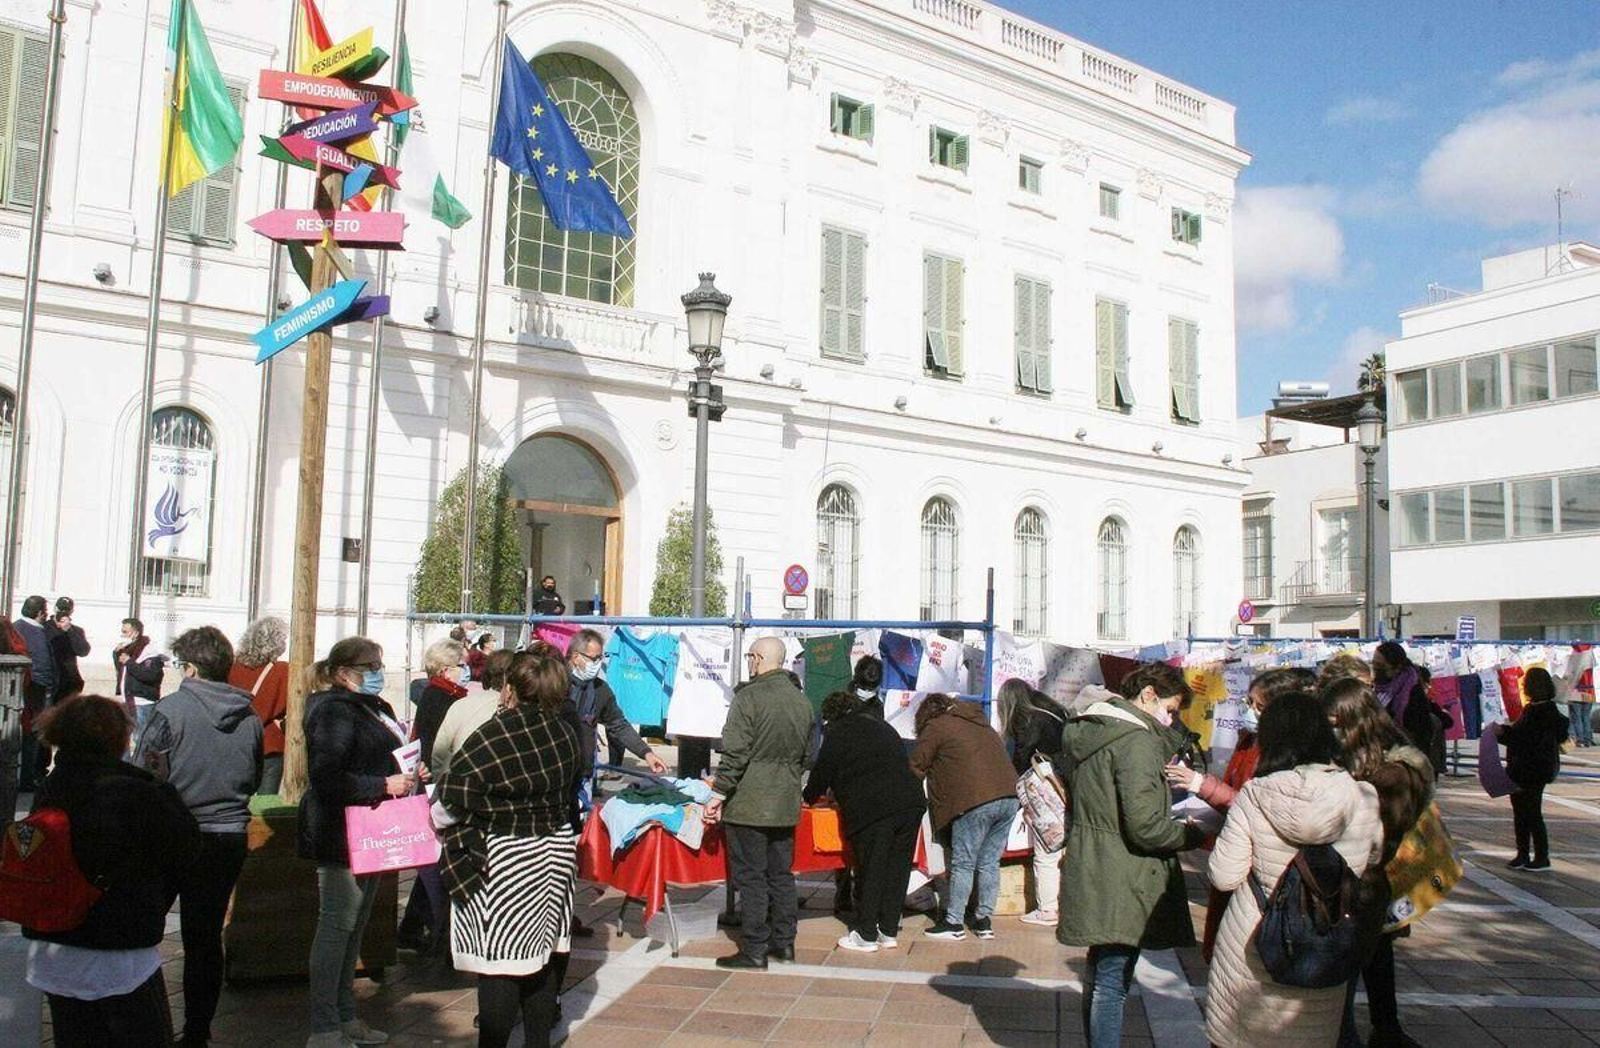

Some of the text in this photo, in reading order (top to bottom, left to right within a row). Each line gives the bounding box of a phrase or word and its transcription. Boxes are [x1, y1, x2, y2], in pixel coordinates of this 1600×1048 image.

[311, 42, 357, 76] RESILIENCIA
[284, 79, 378, 104] EMPODERAMIENTO
[296, 217, 360, 233] RESPETO
[274, 296, 335, 342] FEMINISMO
